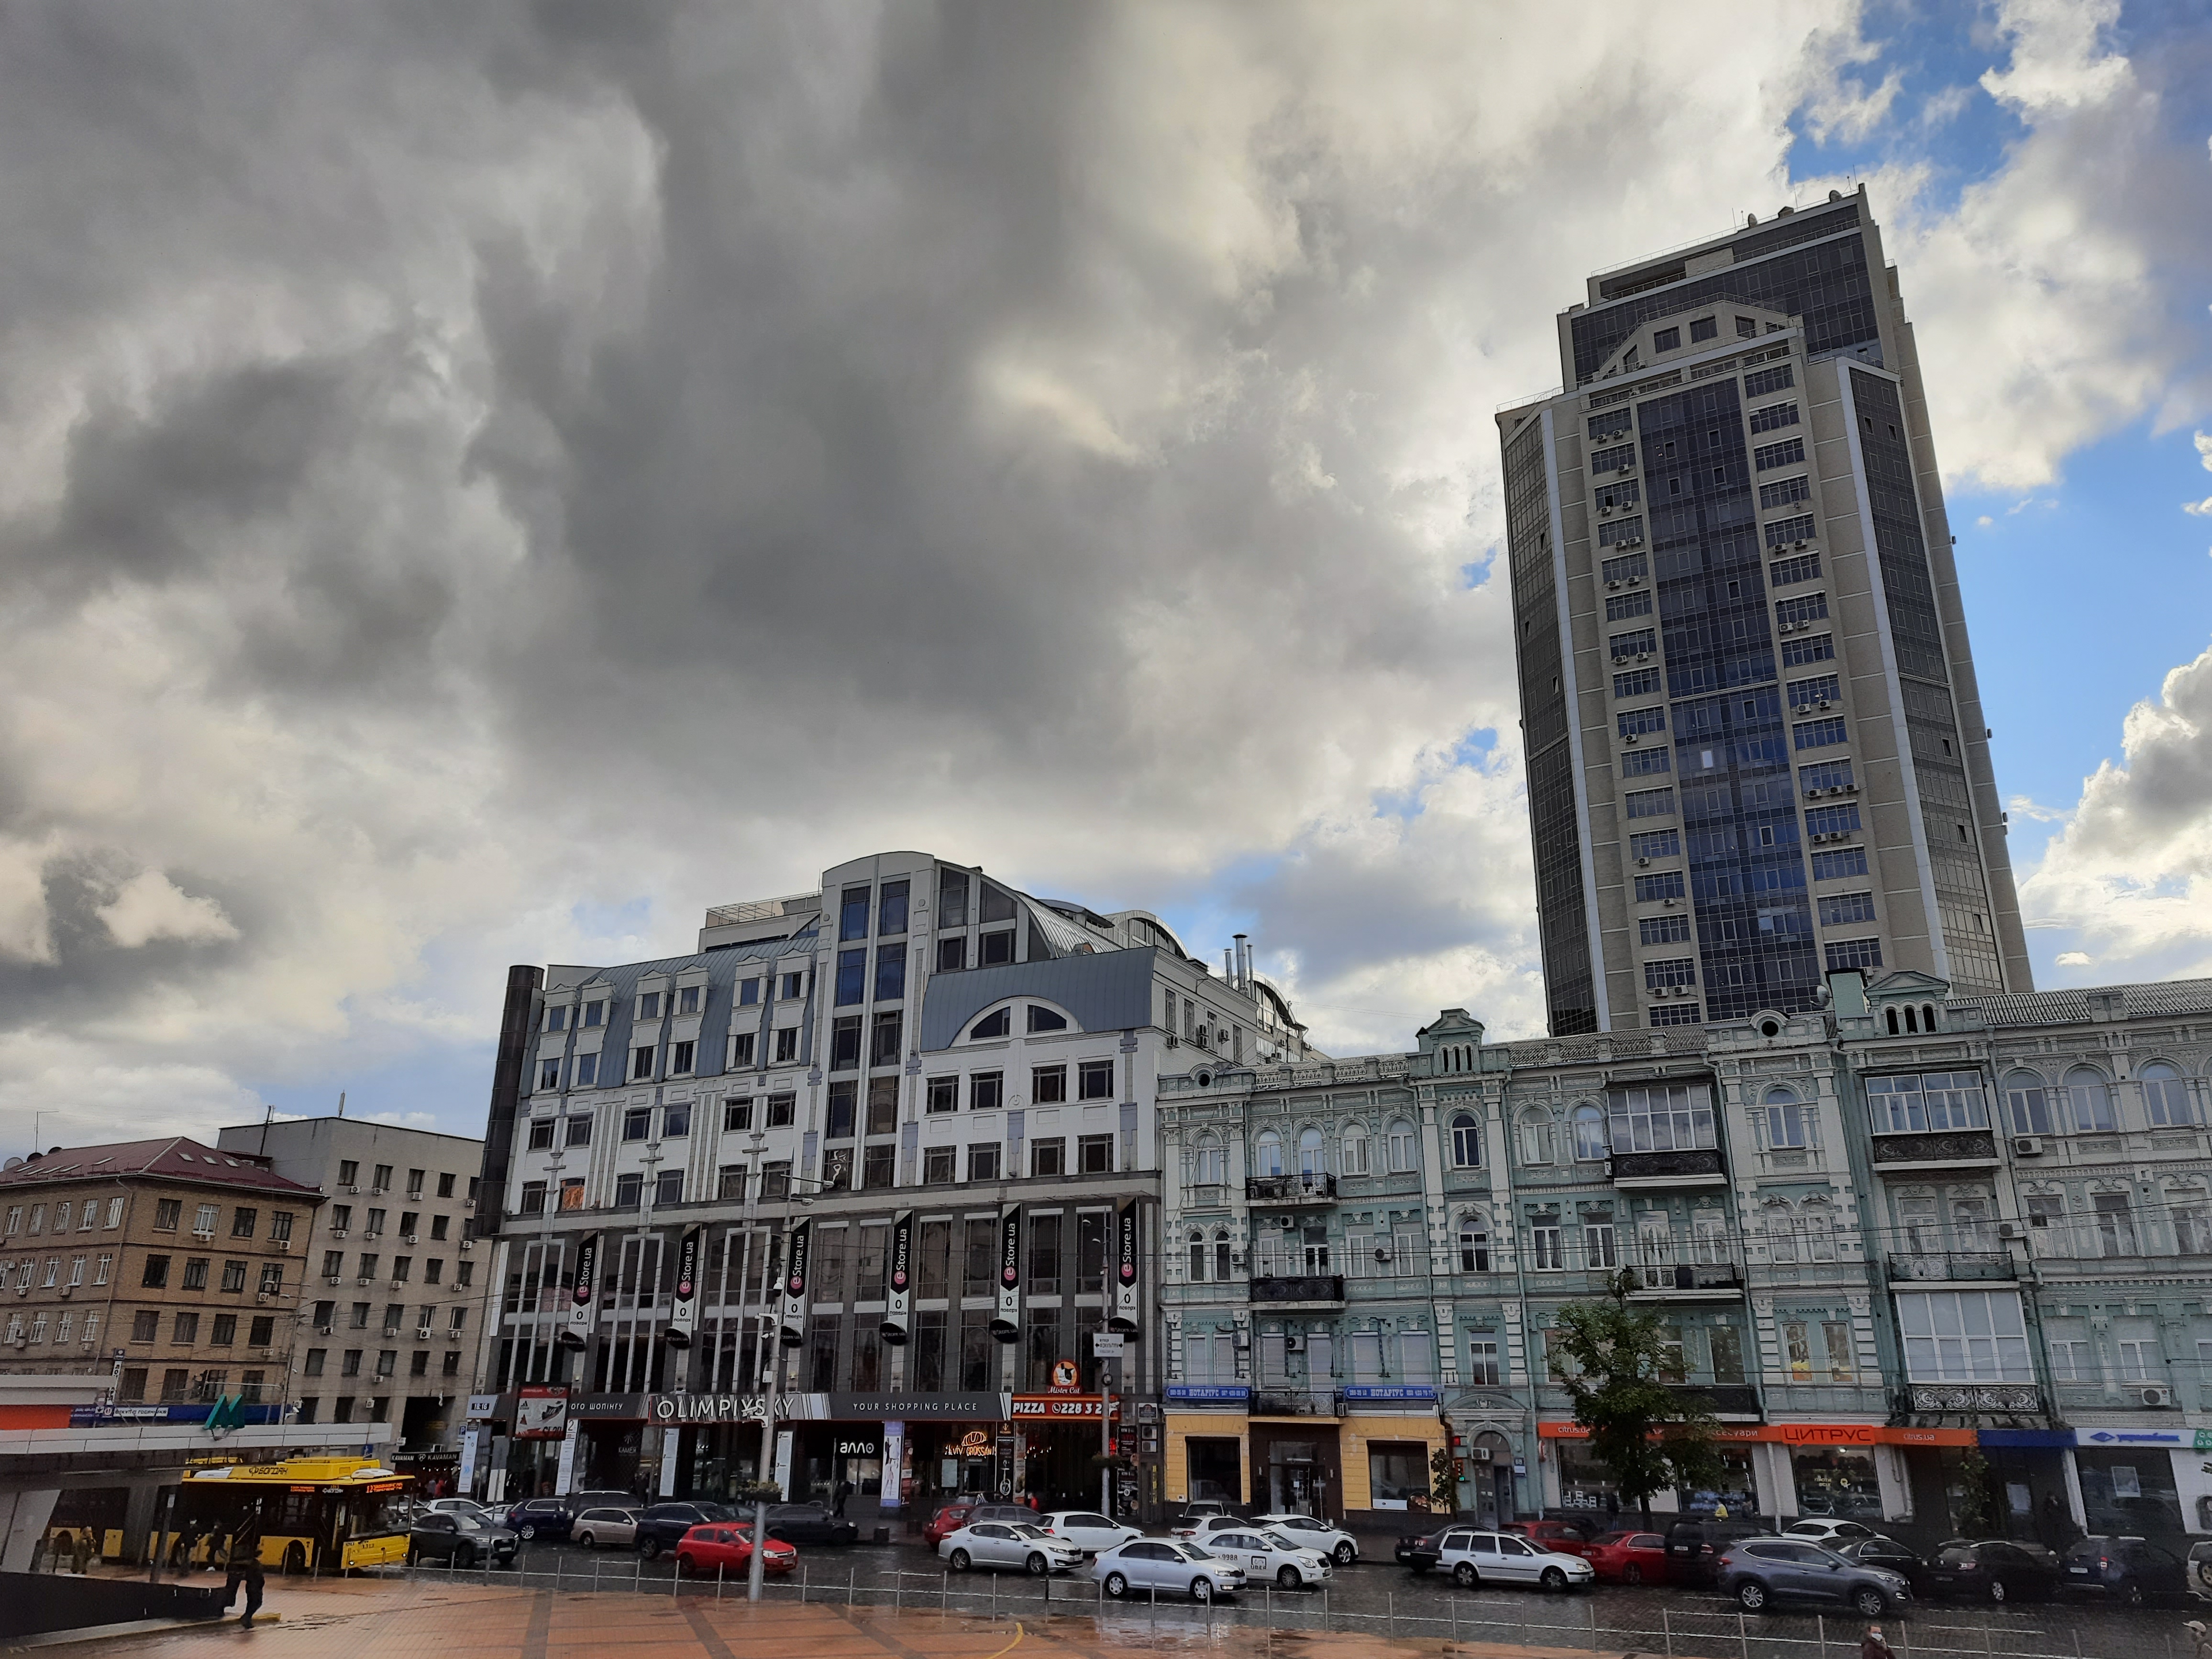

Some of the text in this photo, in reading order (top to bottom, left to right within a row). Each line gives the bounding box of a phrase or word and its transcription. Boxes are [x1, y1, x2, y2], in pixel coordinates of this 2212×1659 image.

[1006, 1296, 1012, 1306] 0
[1124, 1294, 1130, 1303] 0
[791, 1304, 798, 1313] 0
[896, 1300, 902, 1309] 0
[576, 1311, 583, 1319] 0
[680, 1308, 686, 1316] 0
[1371, 1388, 1404, 1396] НОТАРІУС
[589, 1402, 623, 1410] ШОПІНГУ
[853, 1403, 977, 1411] YOUR SHOPPING PLACE
[1013, 1403, 1045, 1414] PIZZA
[1060, 1403, 1082, 1414] 228
[1084, 1403, 1093, 1414] 3
[568, 1420, 575, 1431] 2
[1784, 1428, 1871, 1442] ЦИТРУС
